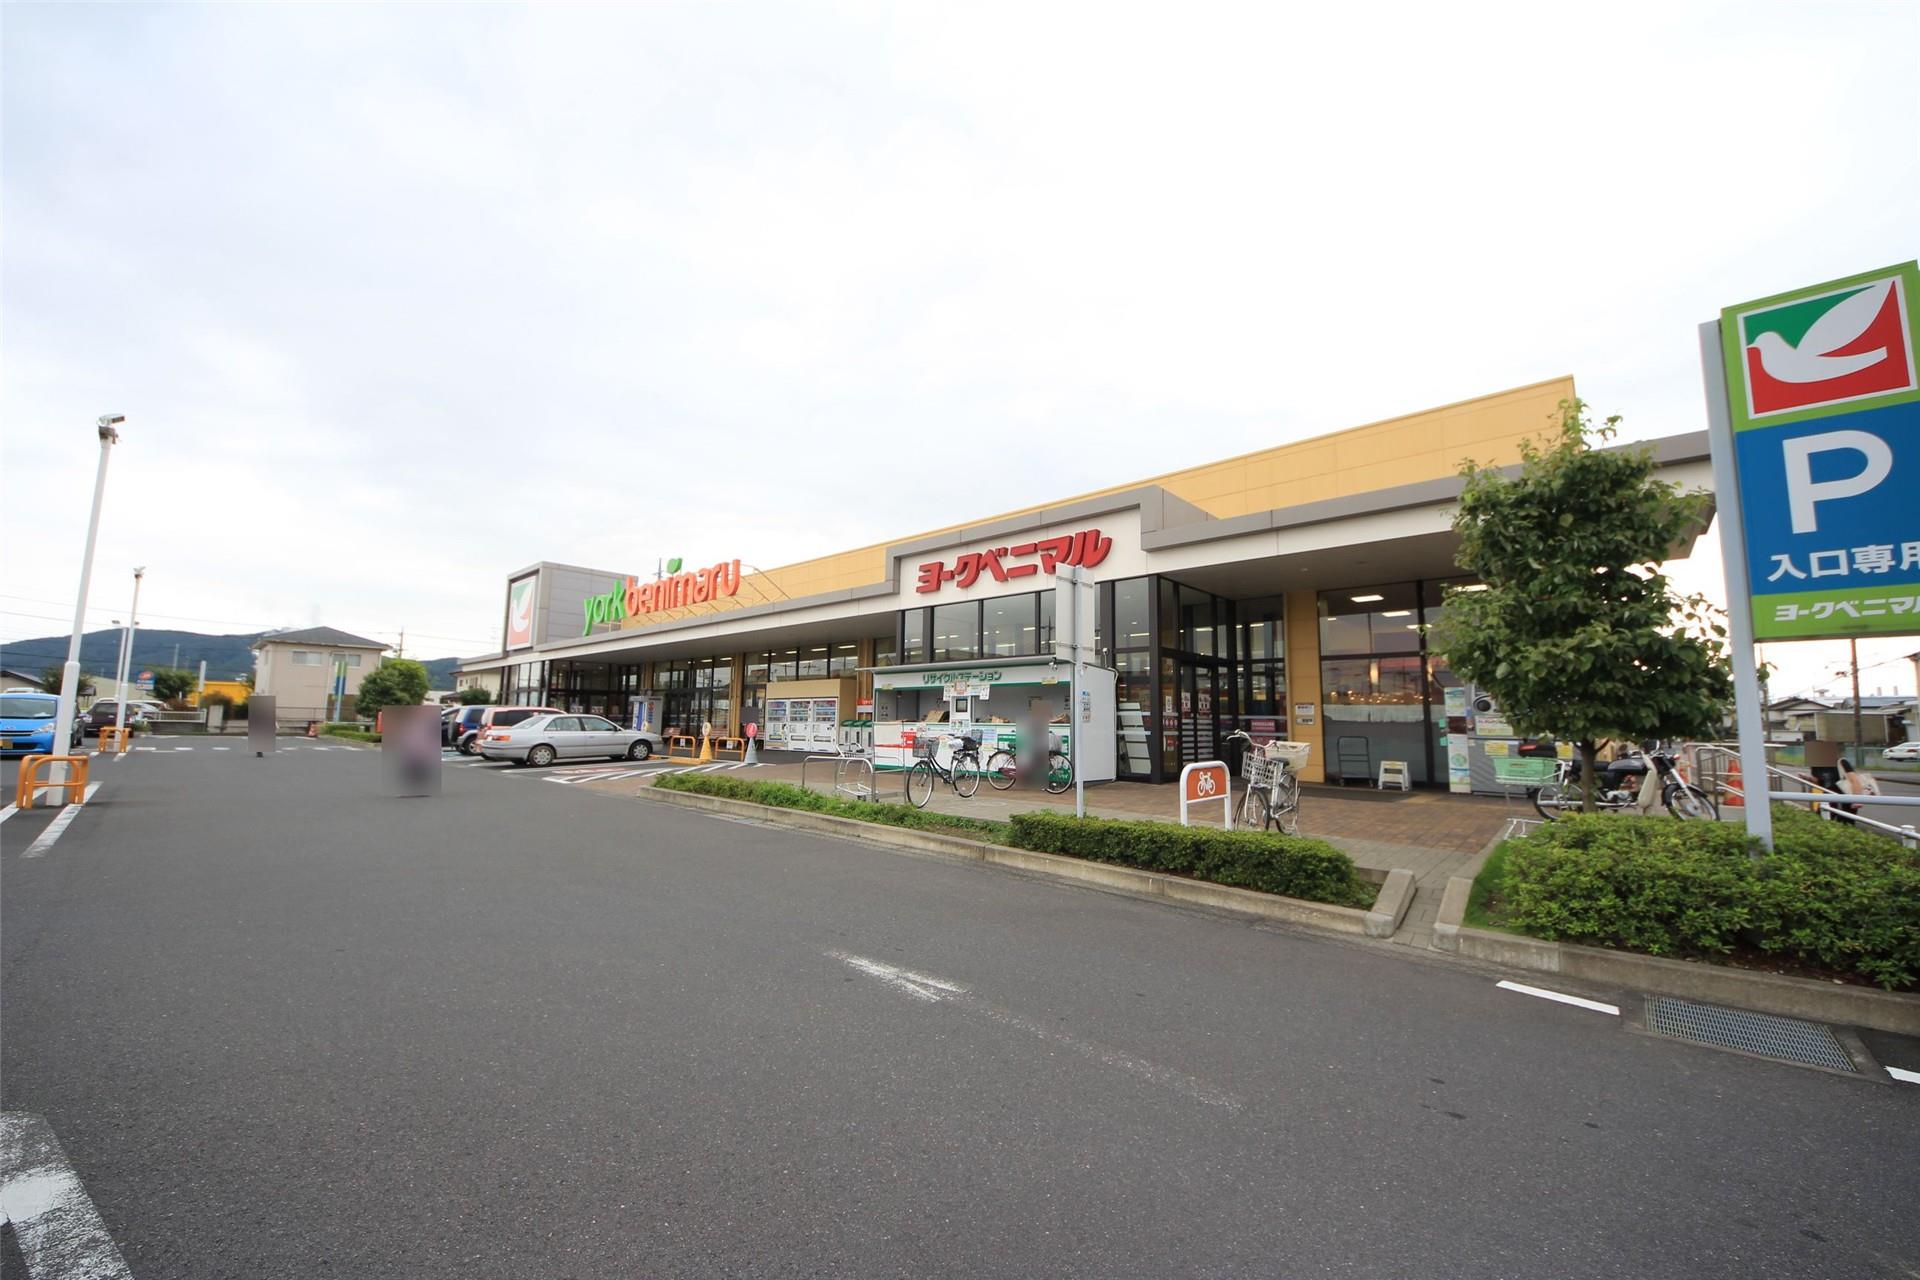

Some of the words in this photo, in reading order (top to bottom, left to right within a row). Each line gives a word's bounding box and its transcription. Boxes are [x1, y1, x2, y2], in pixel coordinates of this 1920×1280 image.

[1782, 430, 1893, 534] P
[916, 529, 1112, 593] ヨークベニマル
[1774, 596, 1920, 621] ヨークベニマ
